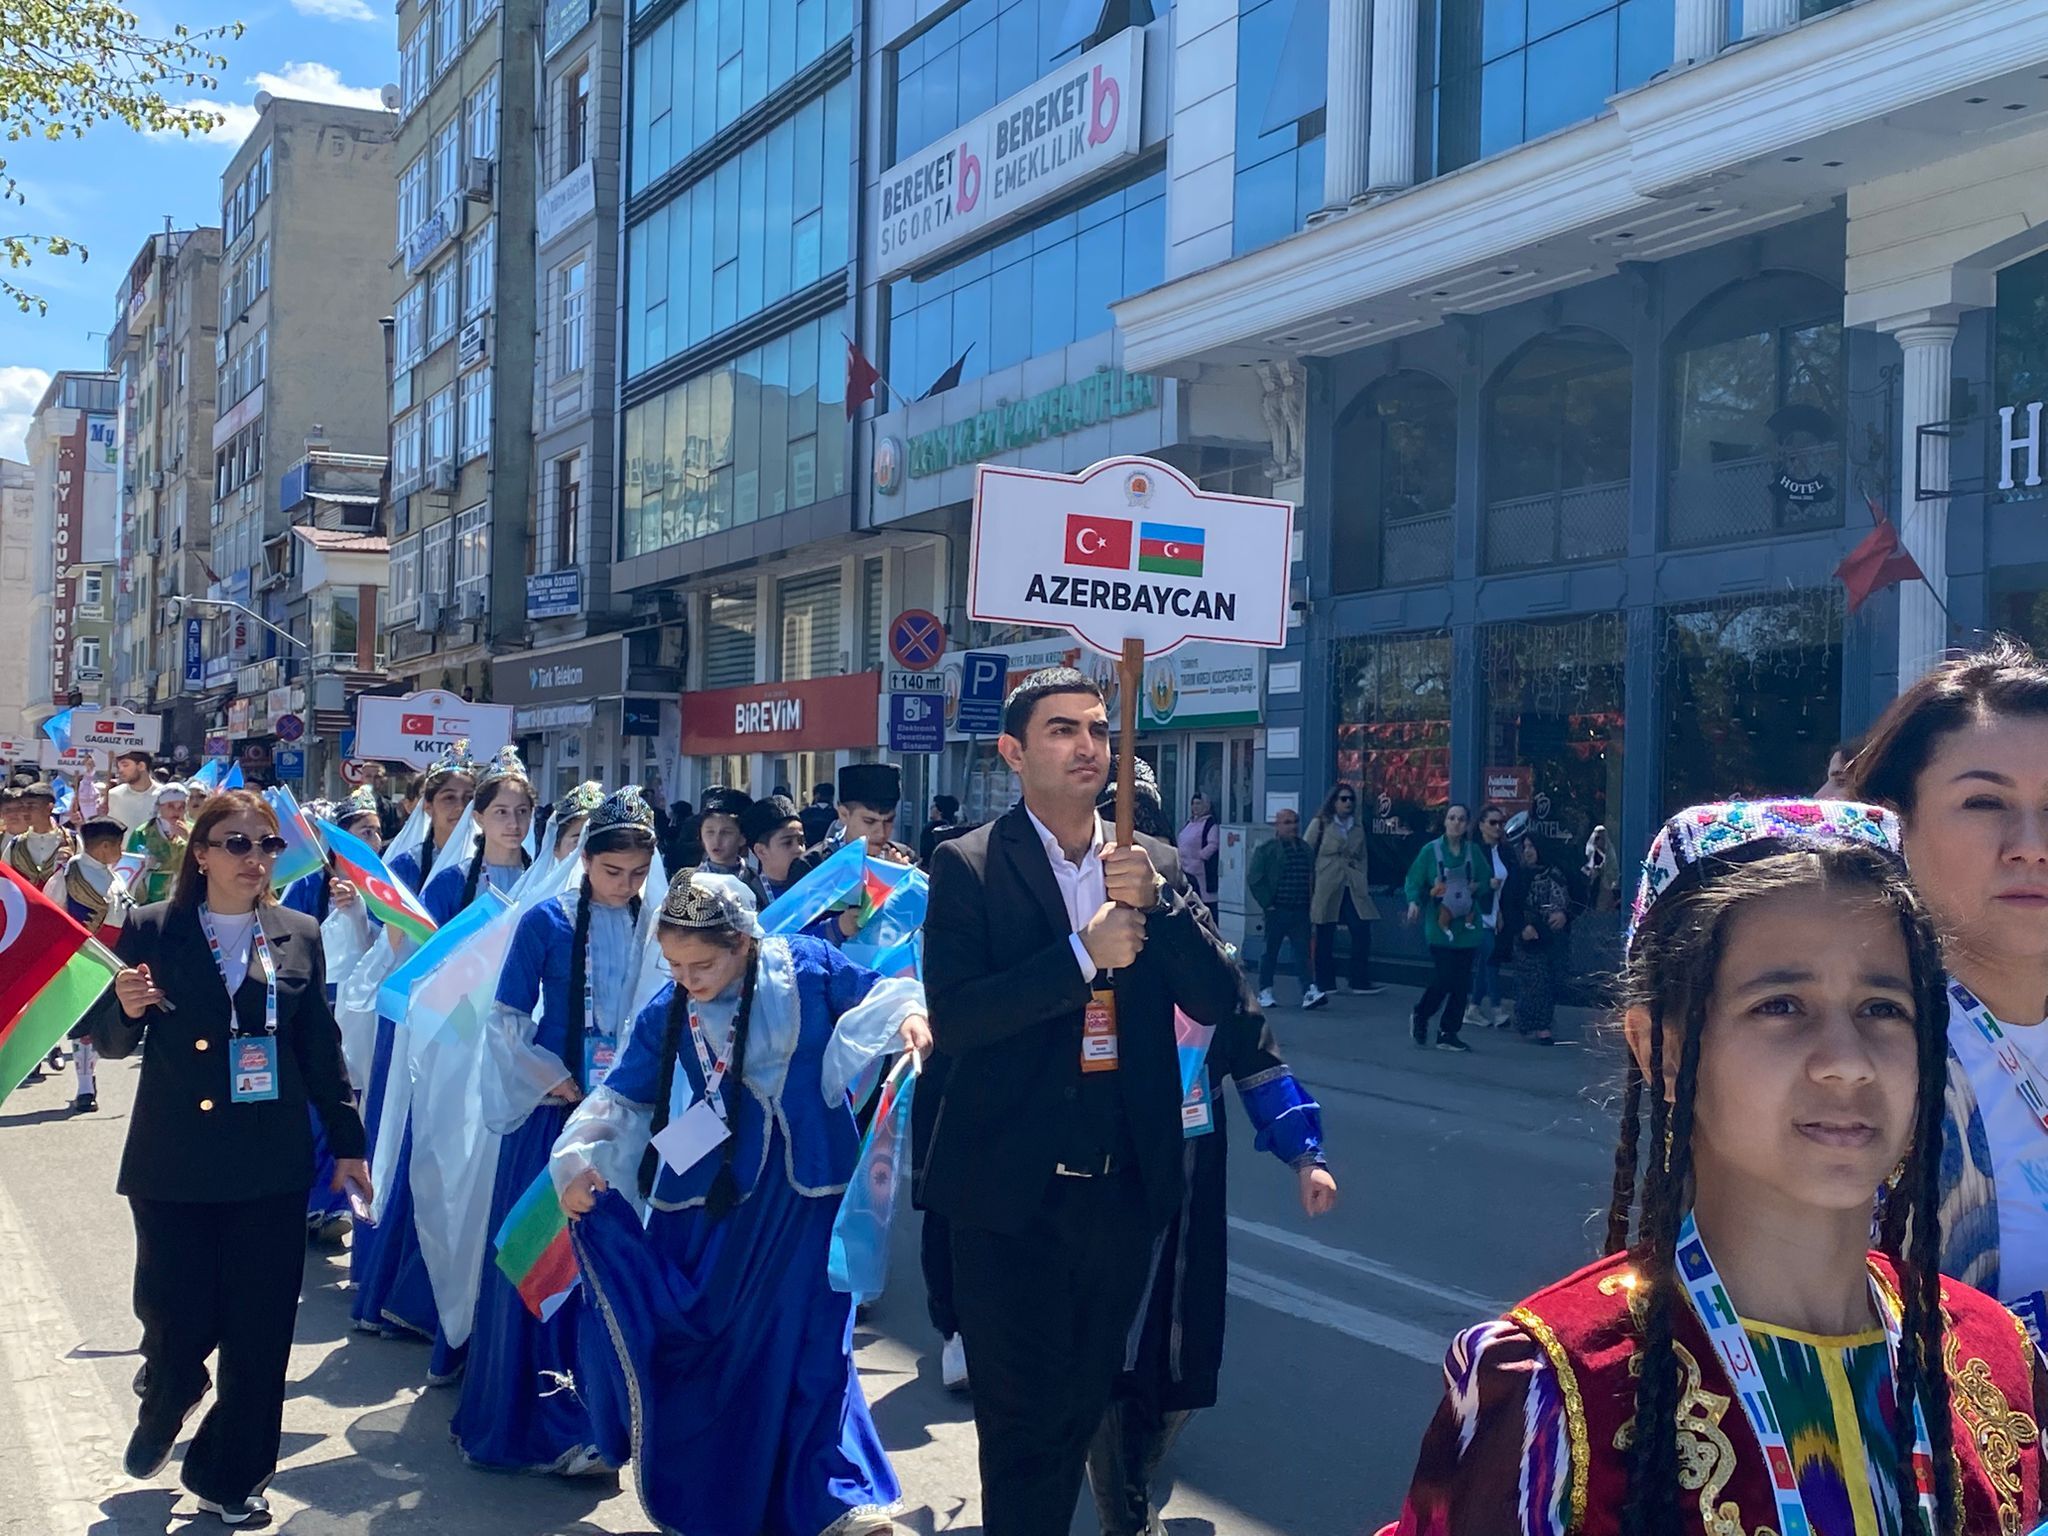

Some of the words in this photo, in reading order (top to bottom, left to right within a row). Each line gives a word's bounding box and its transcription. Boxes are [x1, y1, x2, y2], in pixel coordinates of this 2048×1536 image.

[996, 72, 1089, 160] BEREKET
[994, 121, 1086, 199] EMEKLİLİK
[882, 149, 956, 222] BEREKET
[881, 194, 954, 256] SİGORTA
[90, 423, 115, 447] My
[58, 470, 71, 502] MY
[1780, 475, 1824, 494] HOTEL
[55, 513, 69, 598] HOUSE
[1024, 573, 1236, 622] AZERBAYCAN
[53, 608, 67, 692] HOTEL
[538, 667, 553, 688] Türk
[553, 664, 583, 687] Telekom
[899, 674, 923, 690] 140
[972, 661, 998, 695] P
[735, 698, 800, 735] BİREVİM
[896, 723, 937, 732] Elektronik
[84, 734, 122, 746] GAGAUZ
[123, 736, 144, 747] YERİ
[901, 742, 932, 750] Sistemi
